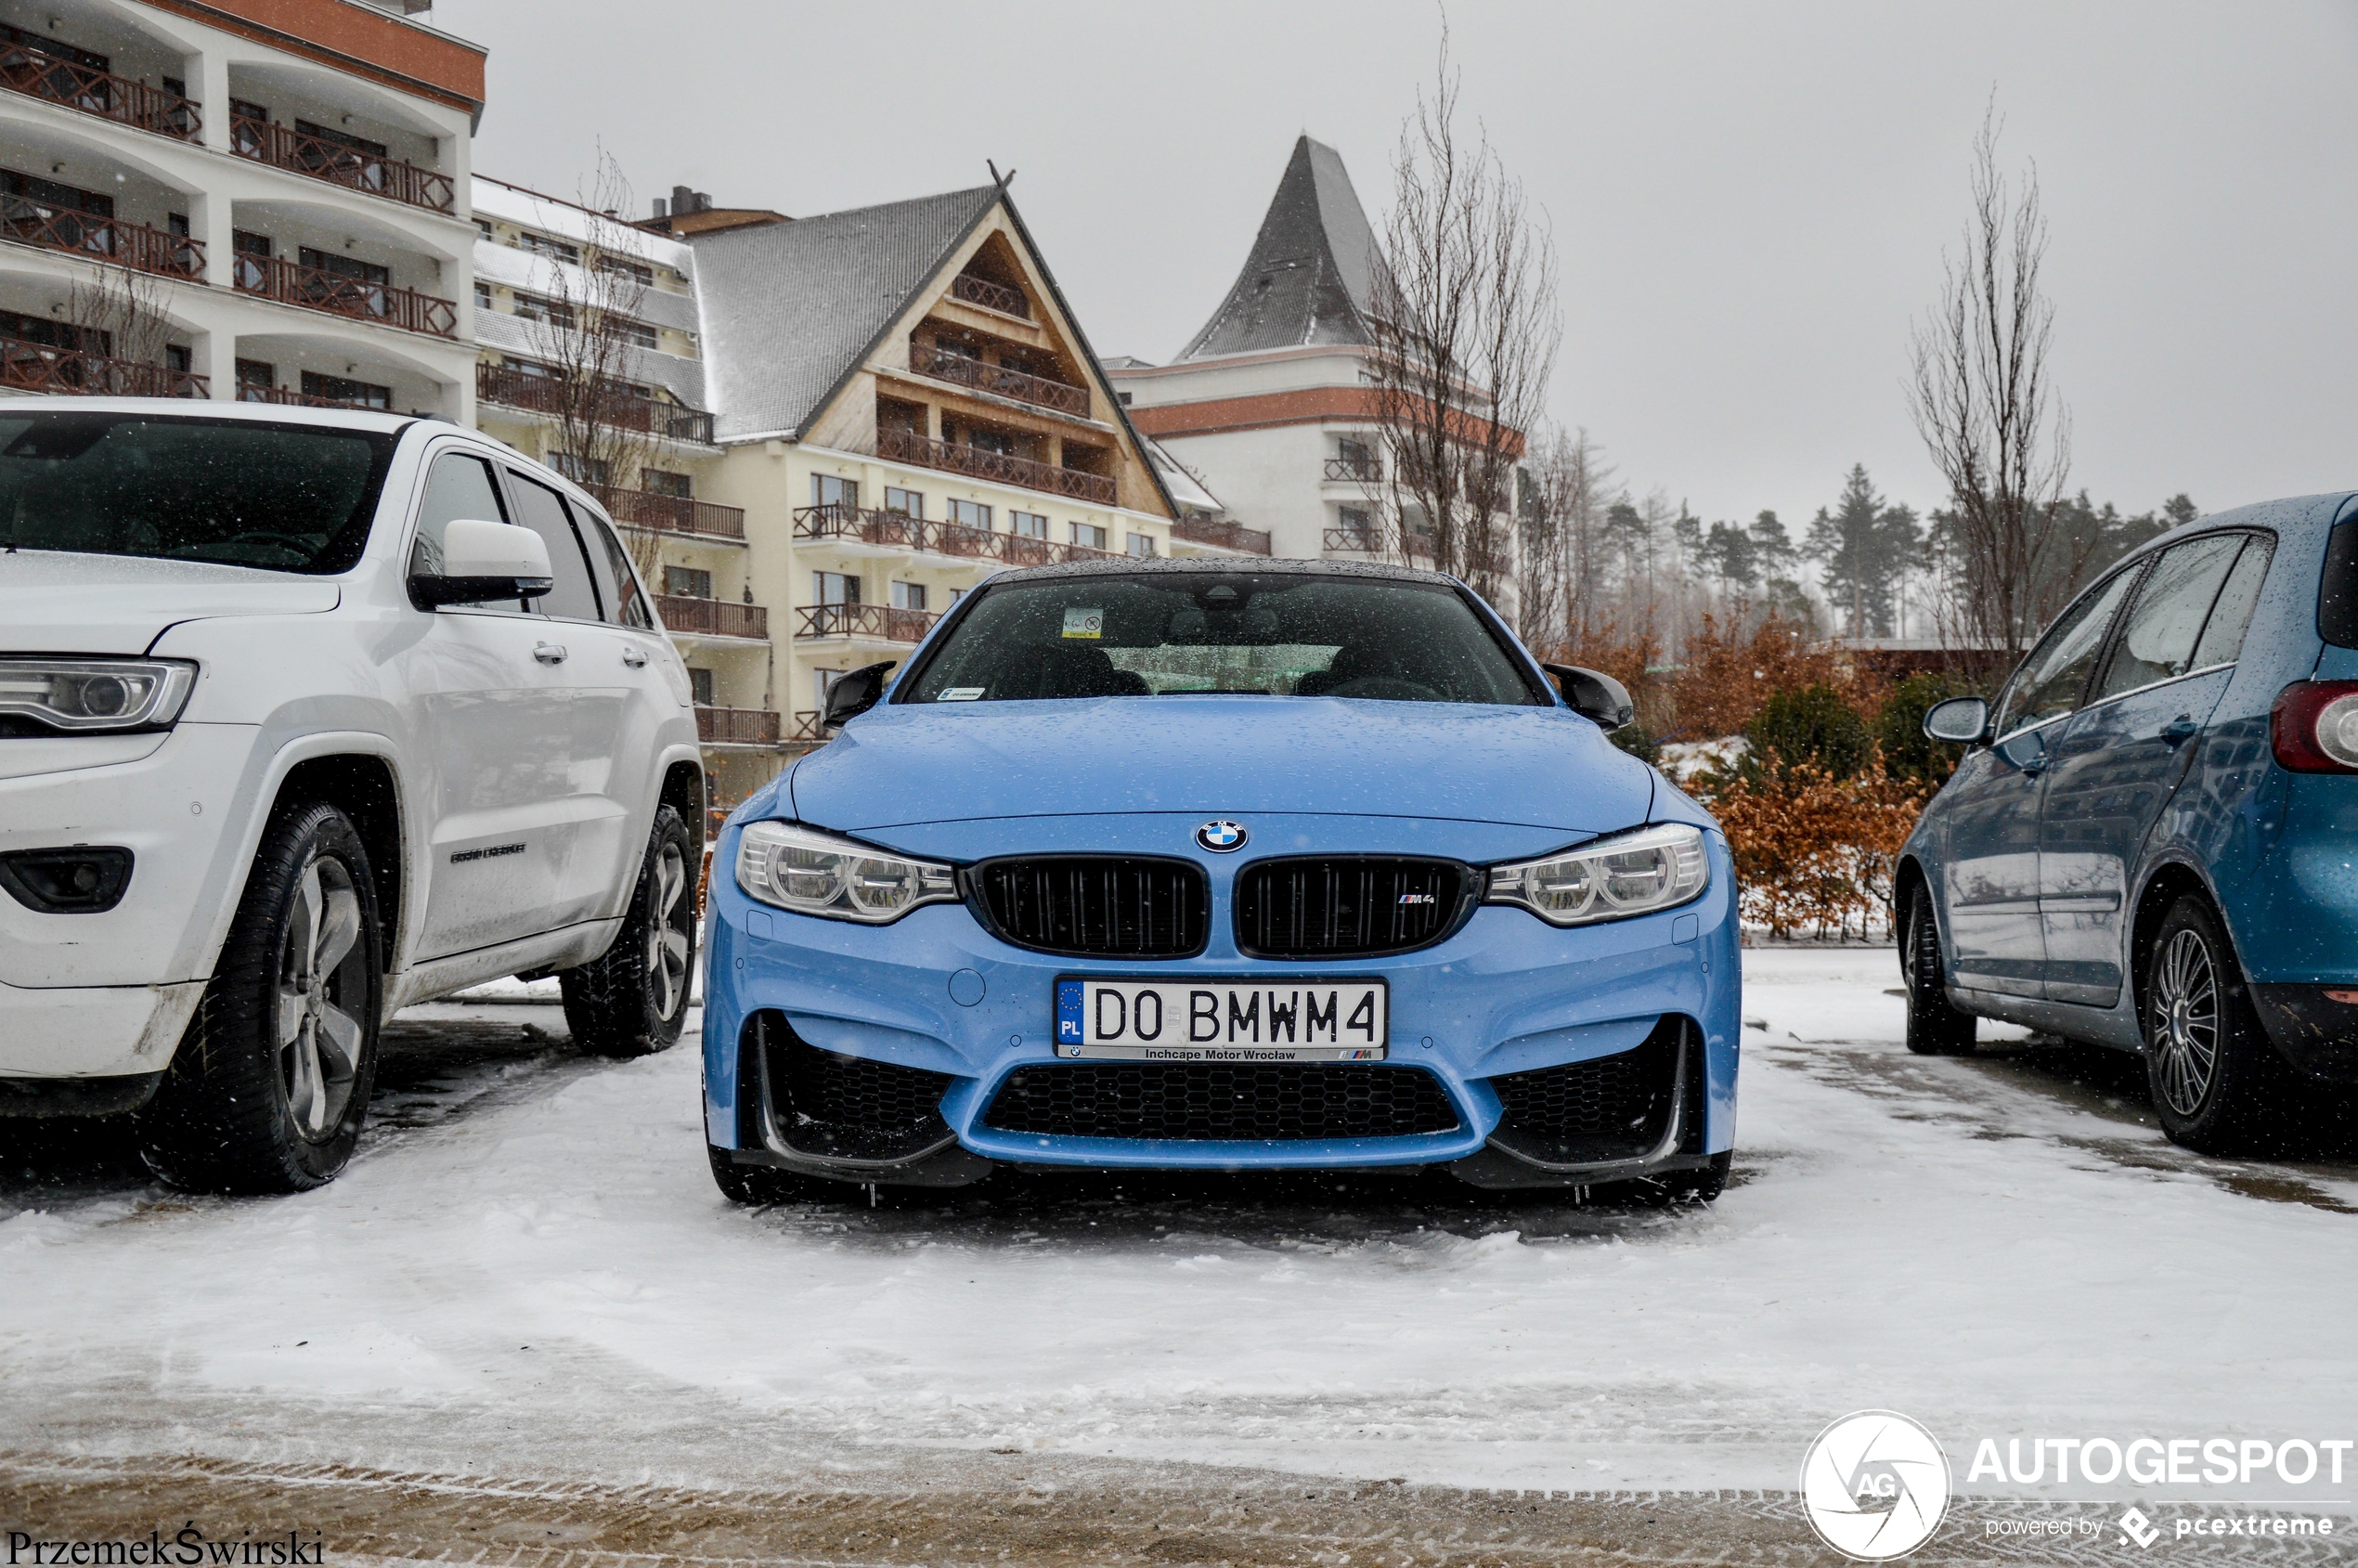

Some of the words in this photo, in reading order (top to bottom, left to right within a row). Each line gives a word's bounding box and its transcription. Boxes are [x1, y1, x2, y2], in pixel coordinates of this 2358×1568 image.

[1201, 821, 1244, 831] BMW
[1408, 894, 1435, 904] M4
[1190, 991, 1375, 1043] BMWM4
[1061, 1021, 1081, 1035] PL
[1146, 1049, 1201, 1061] Inchcape
[1205, 1050, 1241, 1060] Motor
[1243, 1050, 1296, 1060] Wrocław
